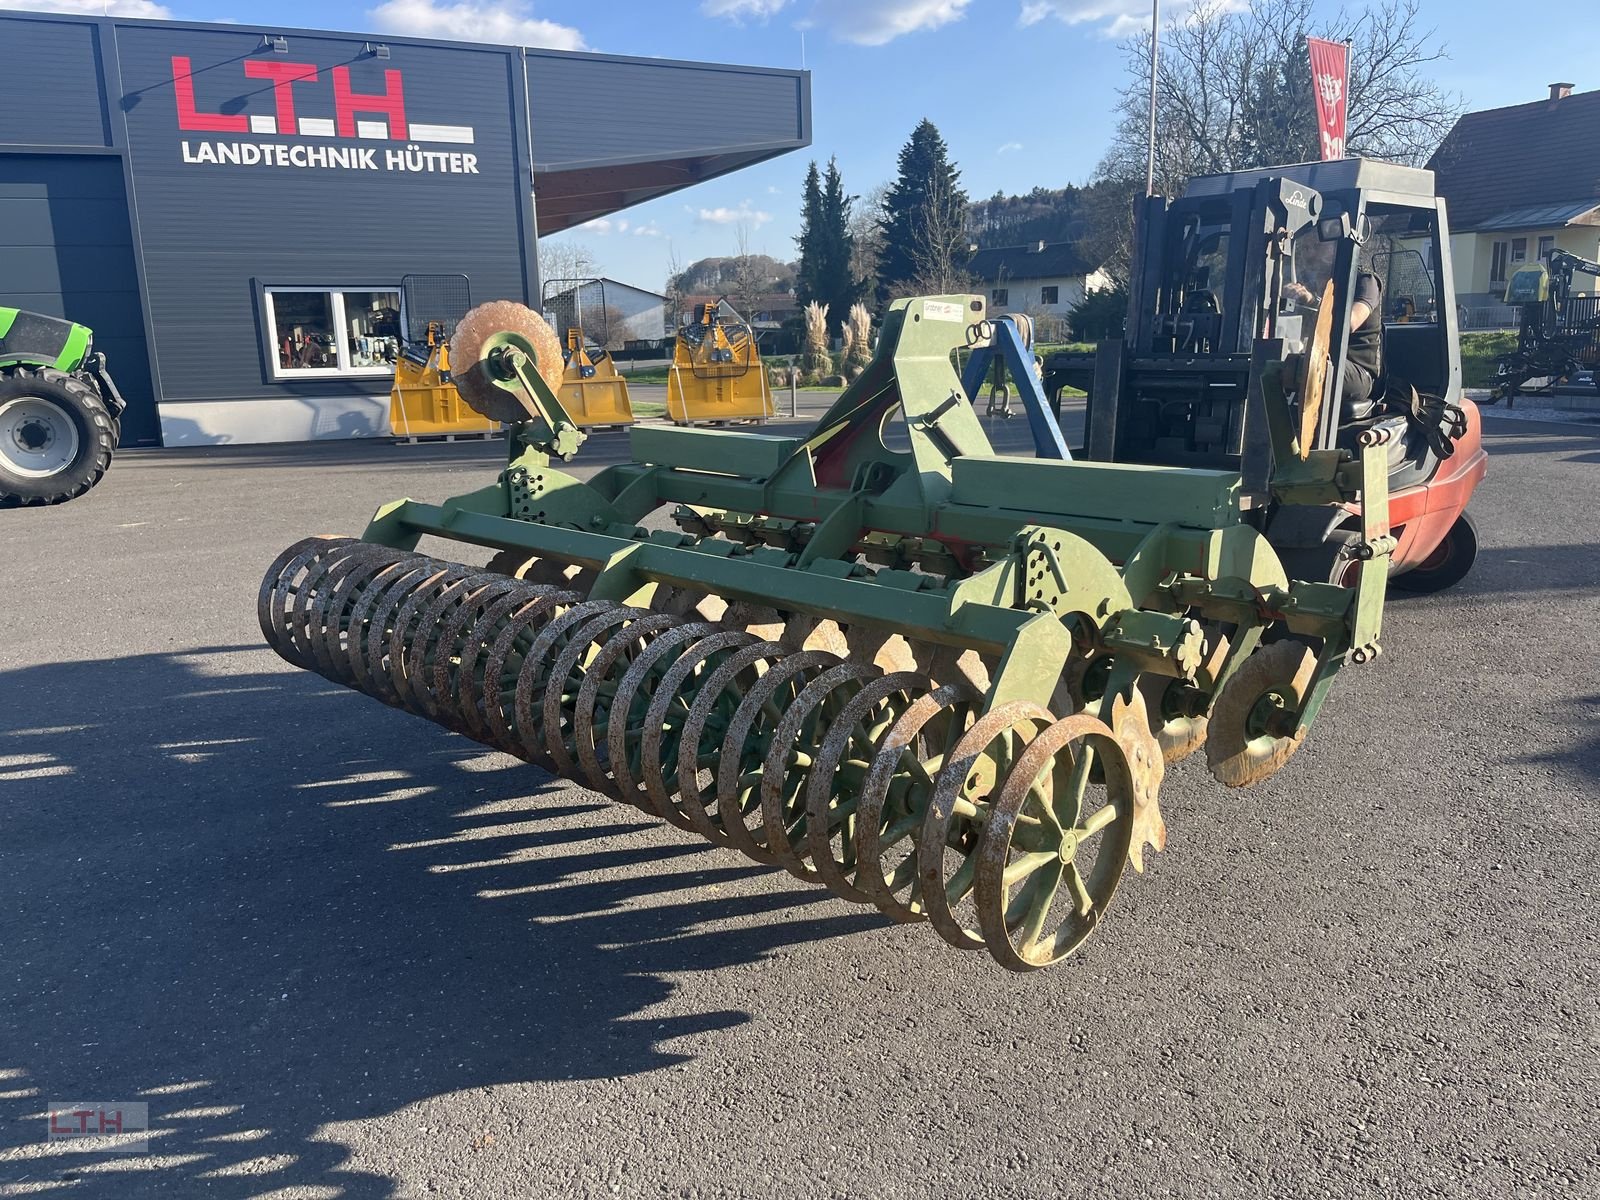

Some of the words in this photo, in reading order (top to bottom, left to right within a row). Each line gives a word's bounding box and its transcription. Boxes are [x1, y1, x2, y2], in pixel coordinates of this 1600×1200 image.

[181, 141, 379, 171] LANDTECHNIK
[385, 145, 480, 175] HÜTTER
[1285, 190, 1308, 210] Linde
